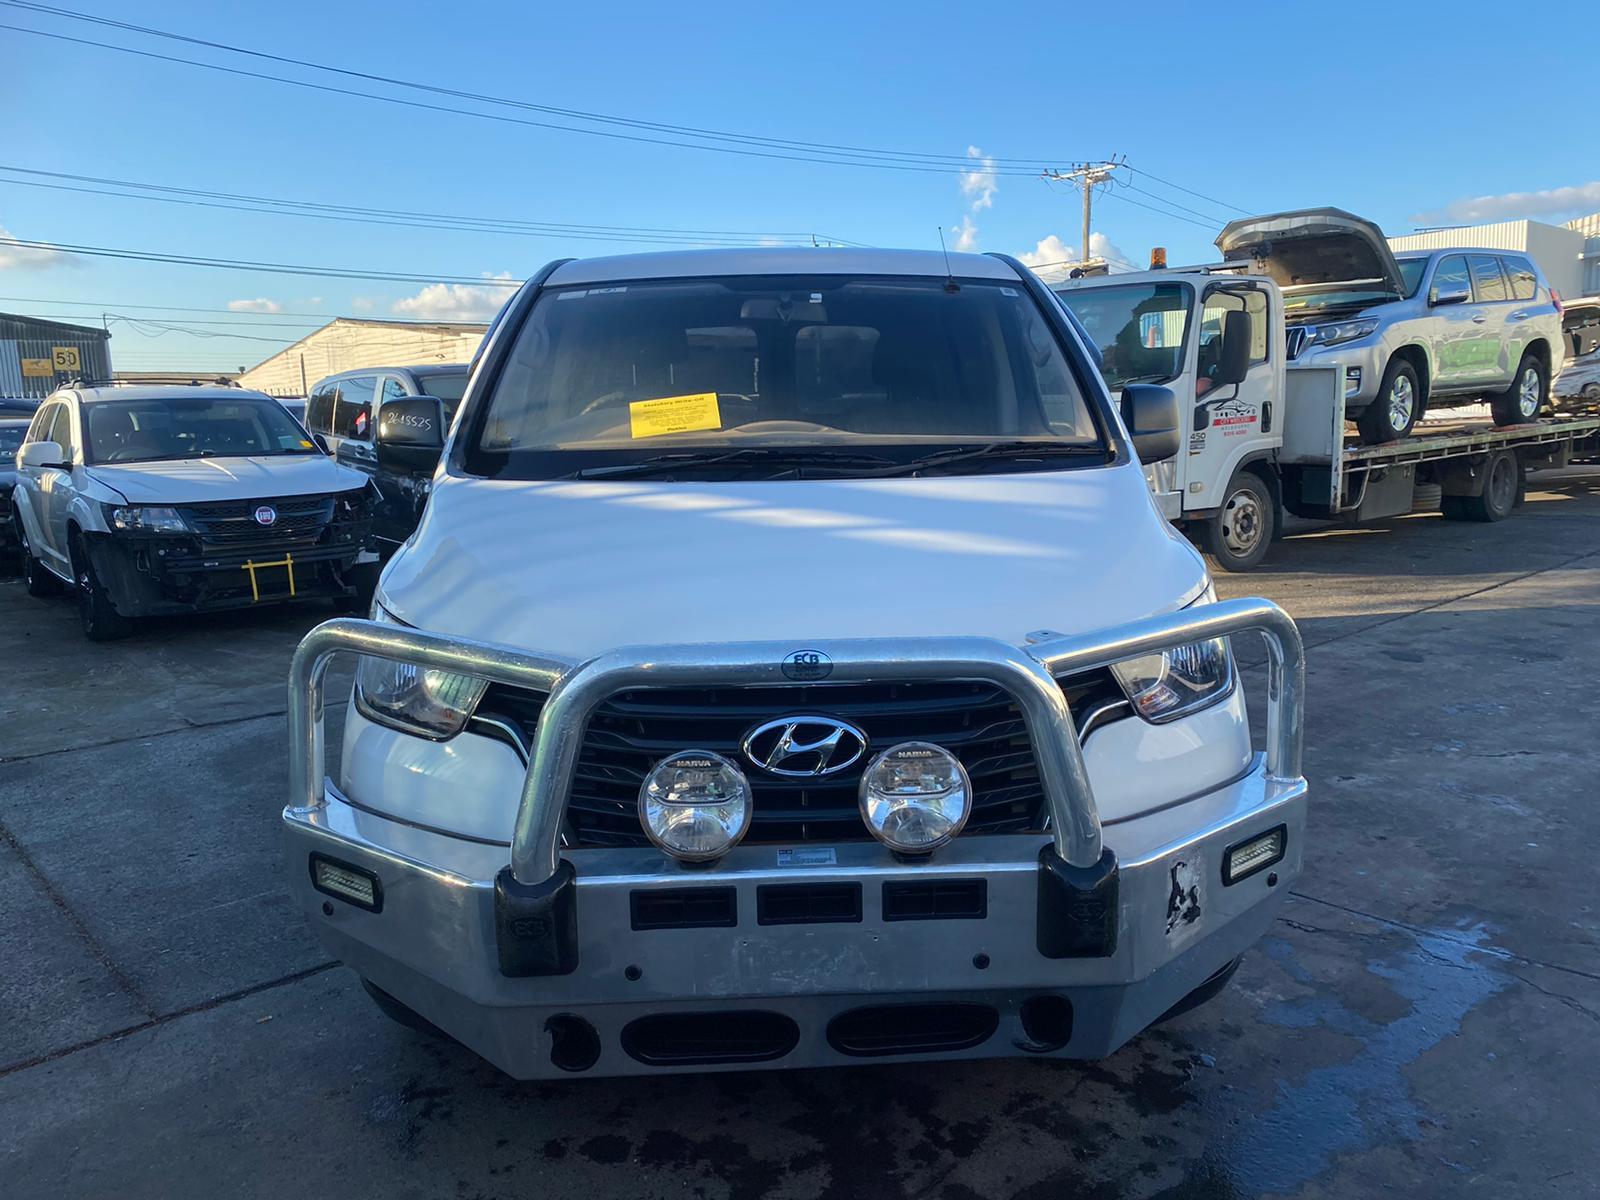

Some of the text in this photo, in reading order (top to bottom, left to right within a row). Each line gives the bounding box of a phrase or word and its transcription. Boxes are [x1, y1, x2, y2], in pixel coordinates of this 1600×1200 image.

[56, 351, 77, 366] 50
[1190, 432, 1206, 440] 450
[793, 652, 820, 665] ECB
[898, 750, 932, 758] NARVA
